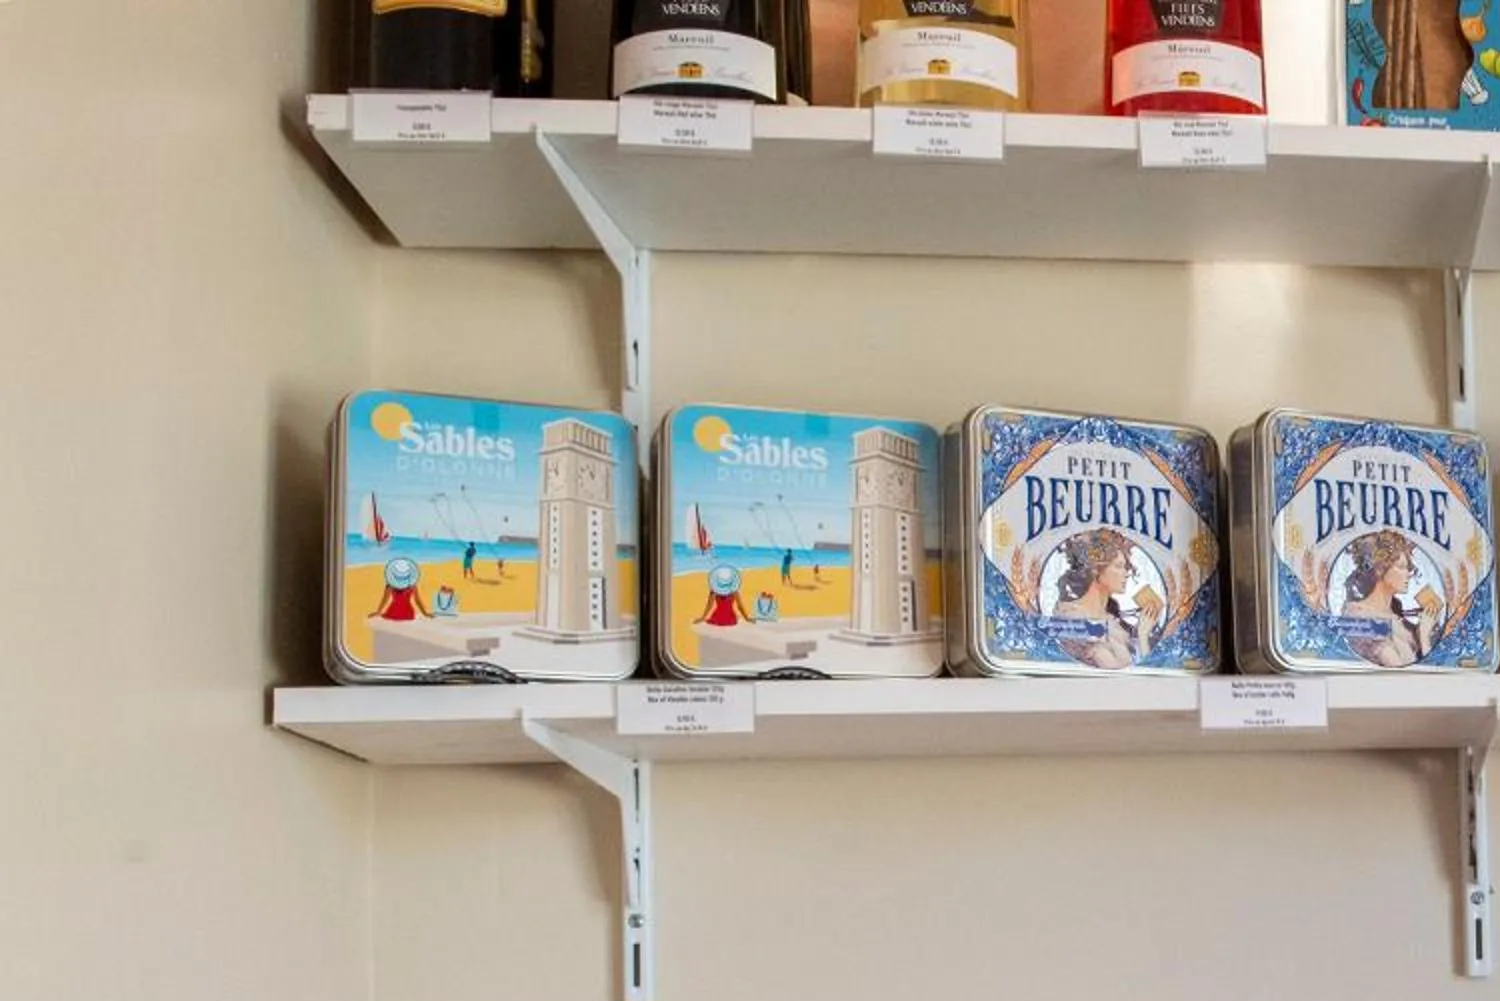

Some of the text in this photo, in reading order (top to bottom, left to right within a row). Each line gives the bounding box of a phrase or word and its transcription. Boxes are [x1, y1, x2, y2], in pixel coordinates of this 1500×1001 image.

[400, 420, 516, 462] Sables
[720, 432, 829, 470] Sables
[1067, 455, 1132, 480] PETIT
[1352, 459, 1412, 482] PETIT
[1024, 475, 1173, 550] BEURRE
[1313, 479, 1451, 551] BEURRE
